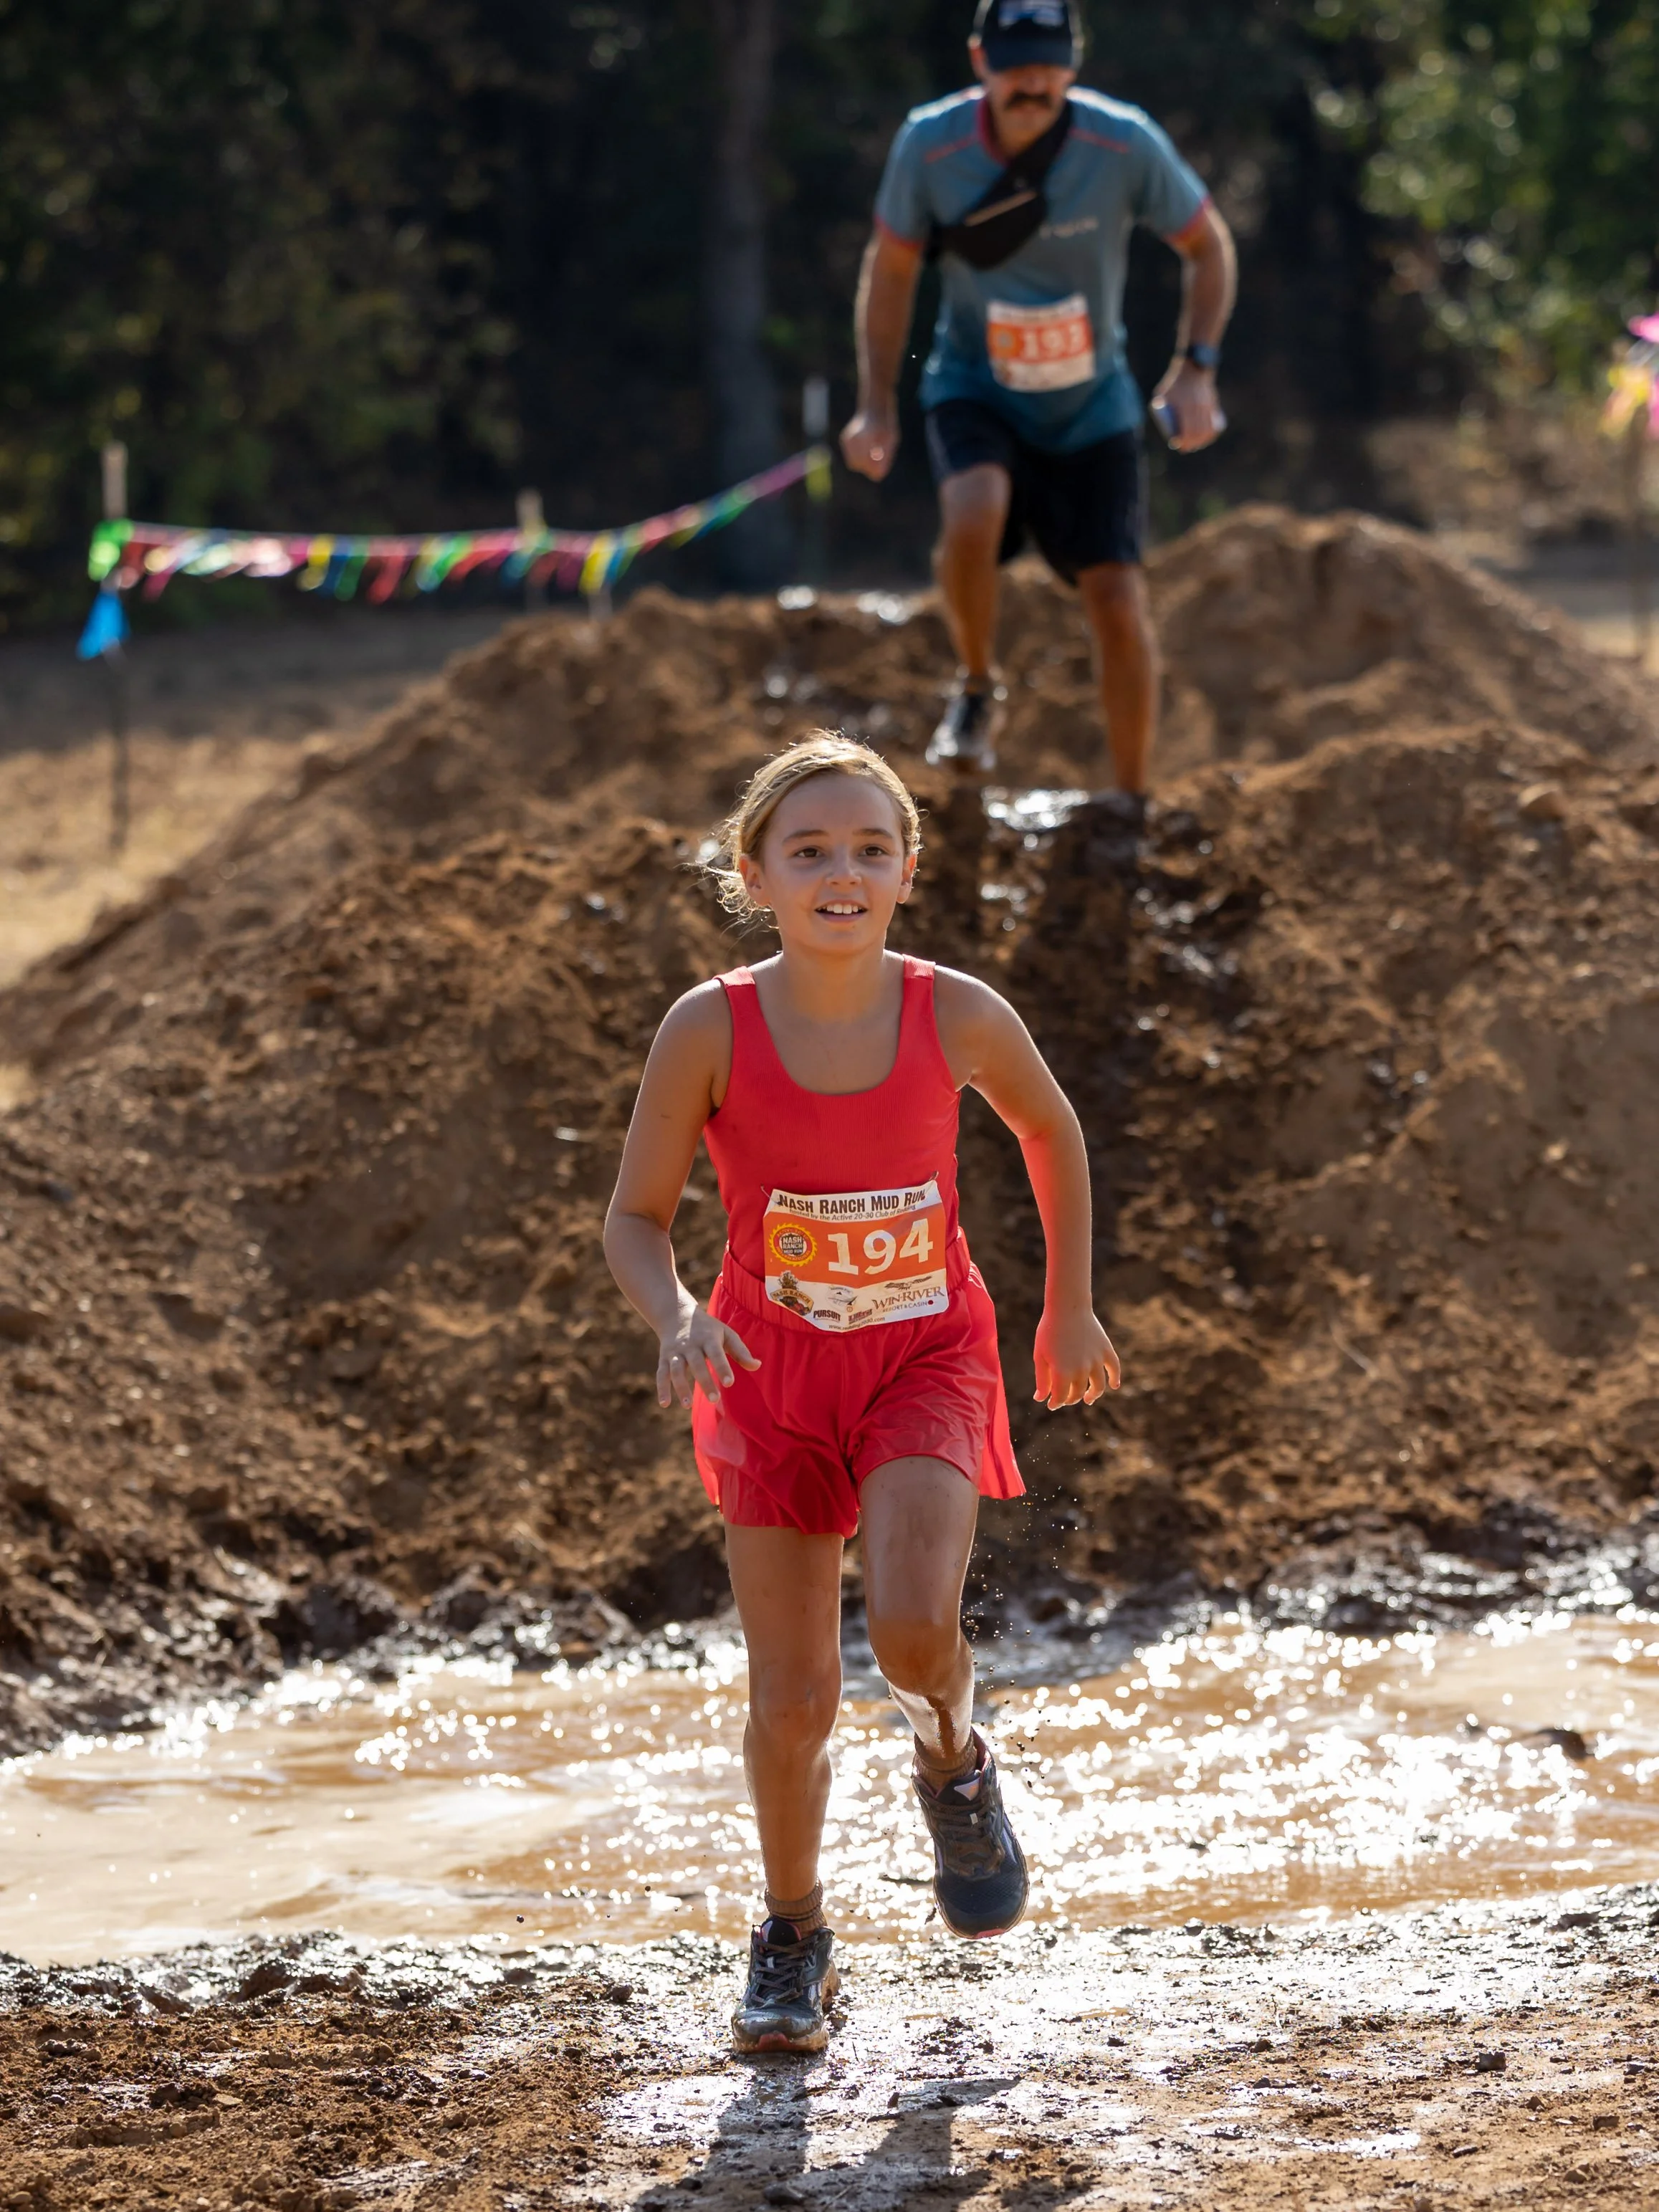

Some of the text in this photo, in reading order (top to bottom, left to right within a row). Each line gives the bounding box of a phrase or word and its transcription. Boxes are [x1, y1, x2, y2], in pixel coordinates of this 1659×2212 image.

[779, 1189, 926, 1215] NASH RANCH MUD RUN
[854, 1212, 874, 1220] 20-30
[827, 1218, 934, 1275] 194
[790, 1291, 811, 1303] RANCH
[813, 1309, 841, 1321] PURSUIT
